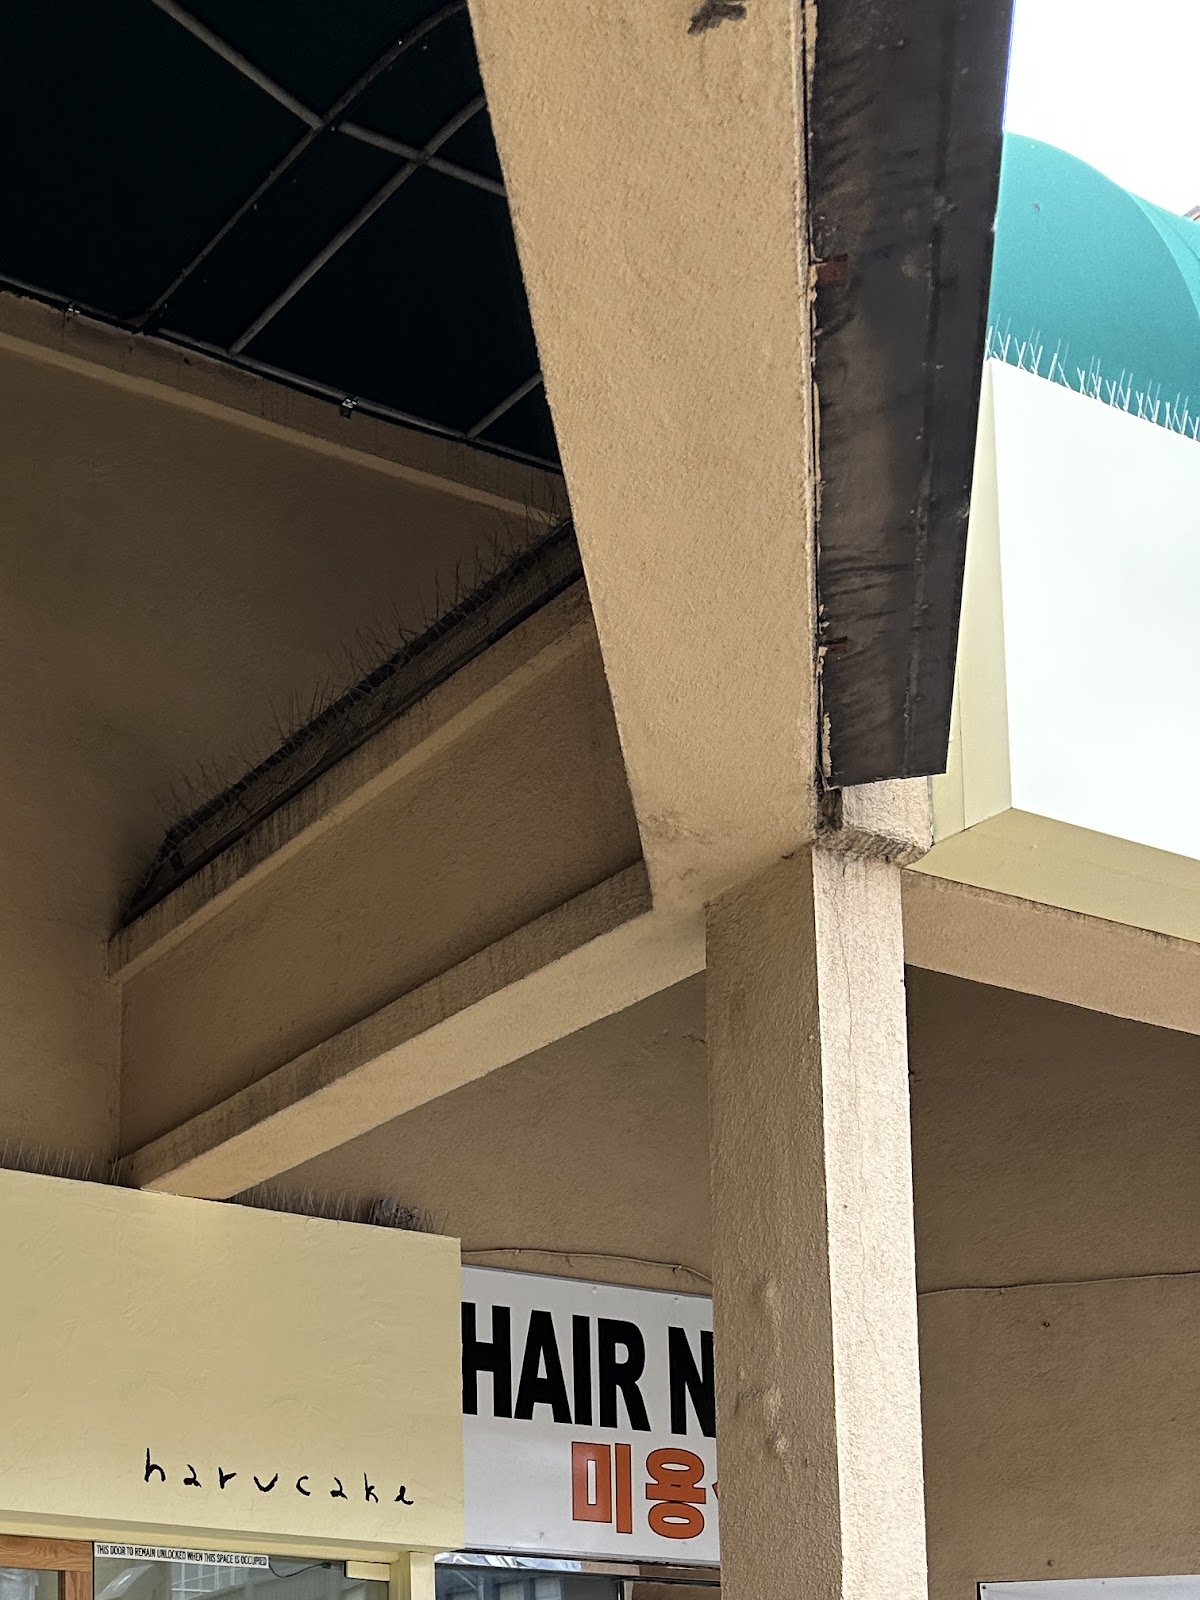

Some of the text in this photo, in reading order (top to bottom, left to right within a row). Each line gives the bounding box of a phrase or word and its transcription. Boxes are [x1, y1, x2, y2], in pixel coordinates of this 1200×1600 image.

[461, 1301, 716, 1438] HAIR N
[144, 1447, 414, 1506] harucake
[571, 1441, 719, 1540] 미용
[97, 1545, 267, 1566] THIS DOOR TO REMAIN UNLOCKED WHEN THIS SPACE IS OCCUPIED
